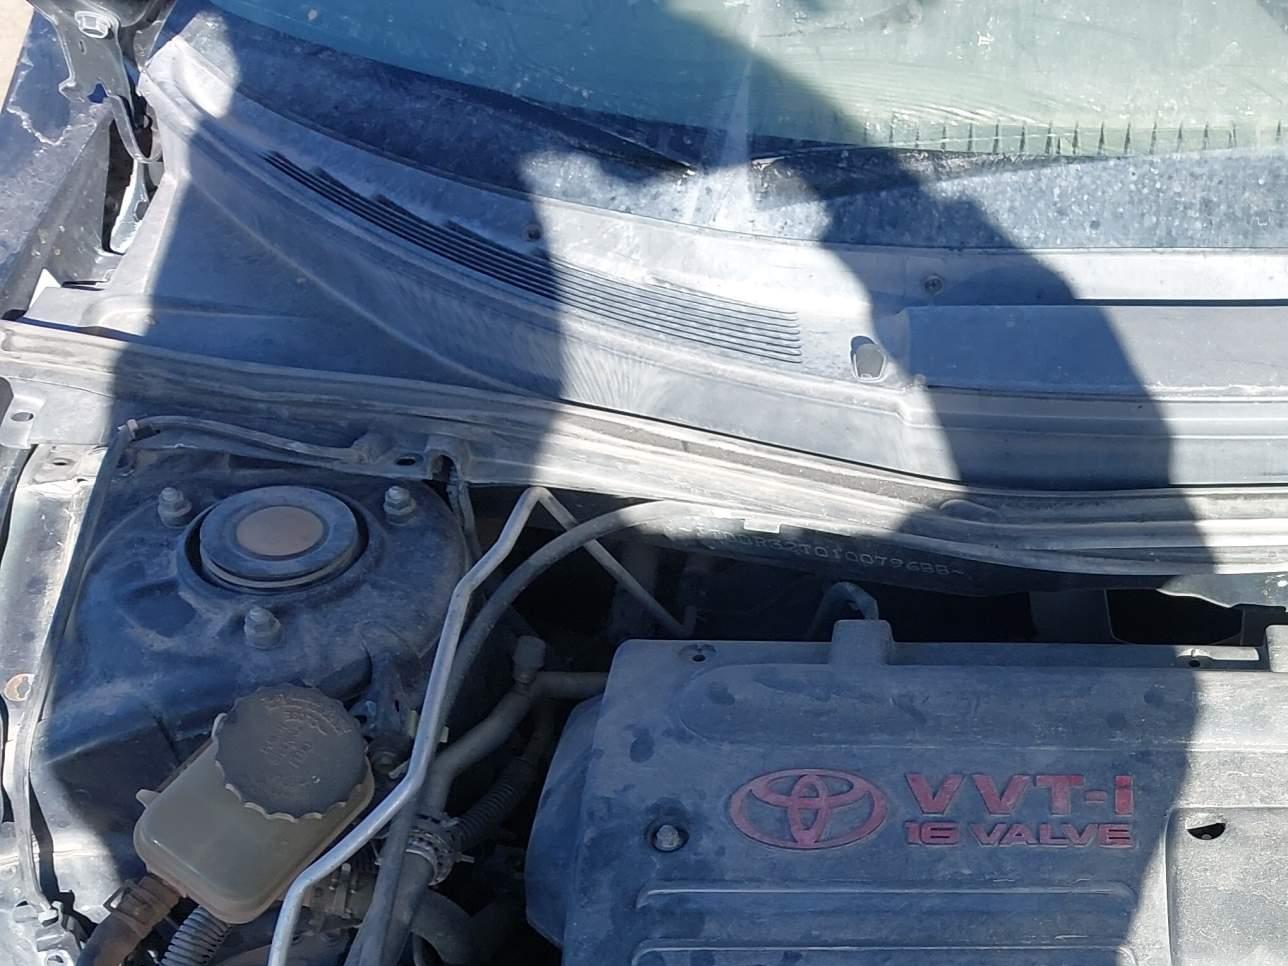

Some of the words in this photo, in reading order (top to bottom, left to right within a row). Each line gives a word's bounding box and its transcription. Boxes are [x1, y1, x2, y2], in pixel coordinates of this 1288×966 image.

[904, 774, 1134, 816] VVT-i
[904, 820, 960, 847] 16
[970, 822, 1136, 848] VALVE
